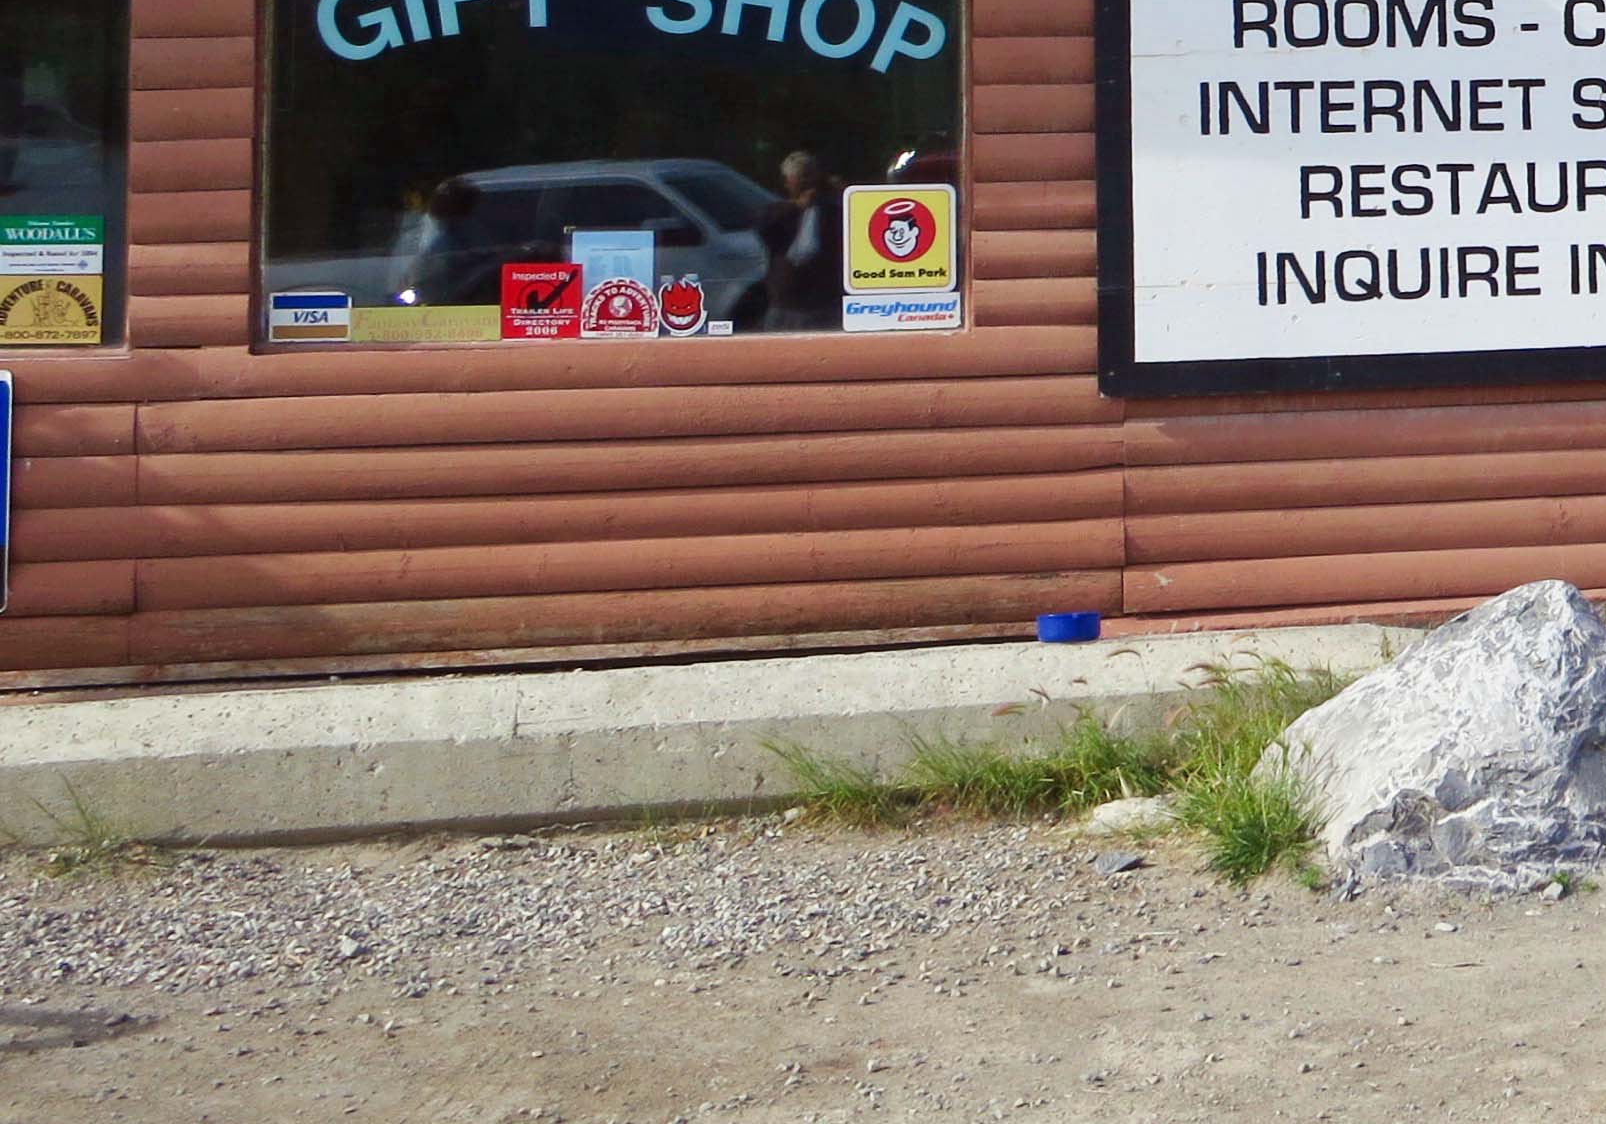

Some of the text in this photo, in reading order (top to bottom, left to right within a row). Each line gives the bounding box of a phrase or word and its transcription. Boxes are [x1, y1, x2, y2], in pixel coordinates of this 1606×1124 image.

[1519, 22, 1540, 32] -
[1199, 78, 1546, 136] INTERNET
[852, 267, 947, 279] Good Sam Park
[1256, 244, 1542, 306] INQUIRE
[55, 280, 99, 327] CARAVANS
[846, 299, 958, 317] Greyhound
[293, 310, 329, 324] VISA
[897, 312, 948, 323] Canada
